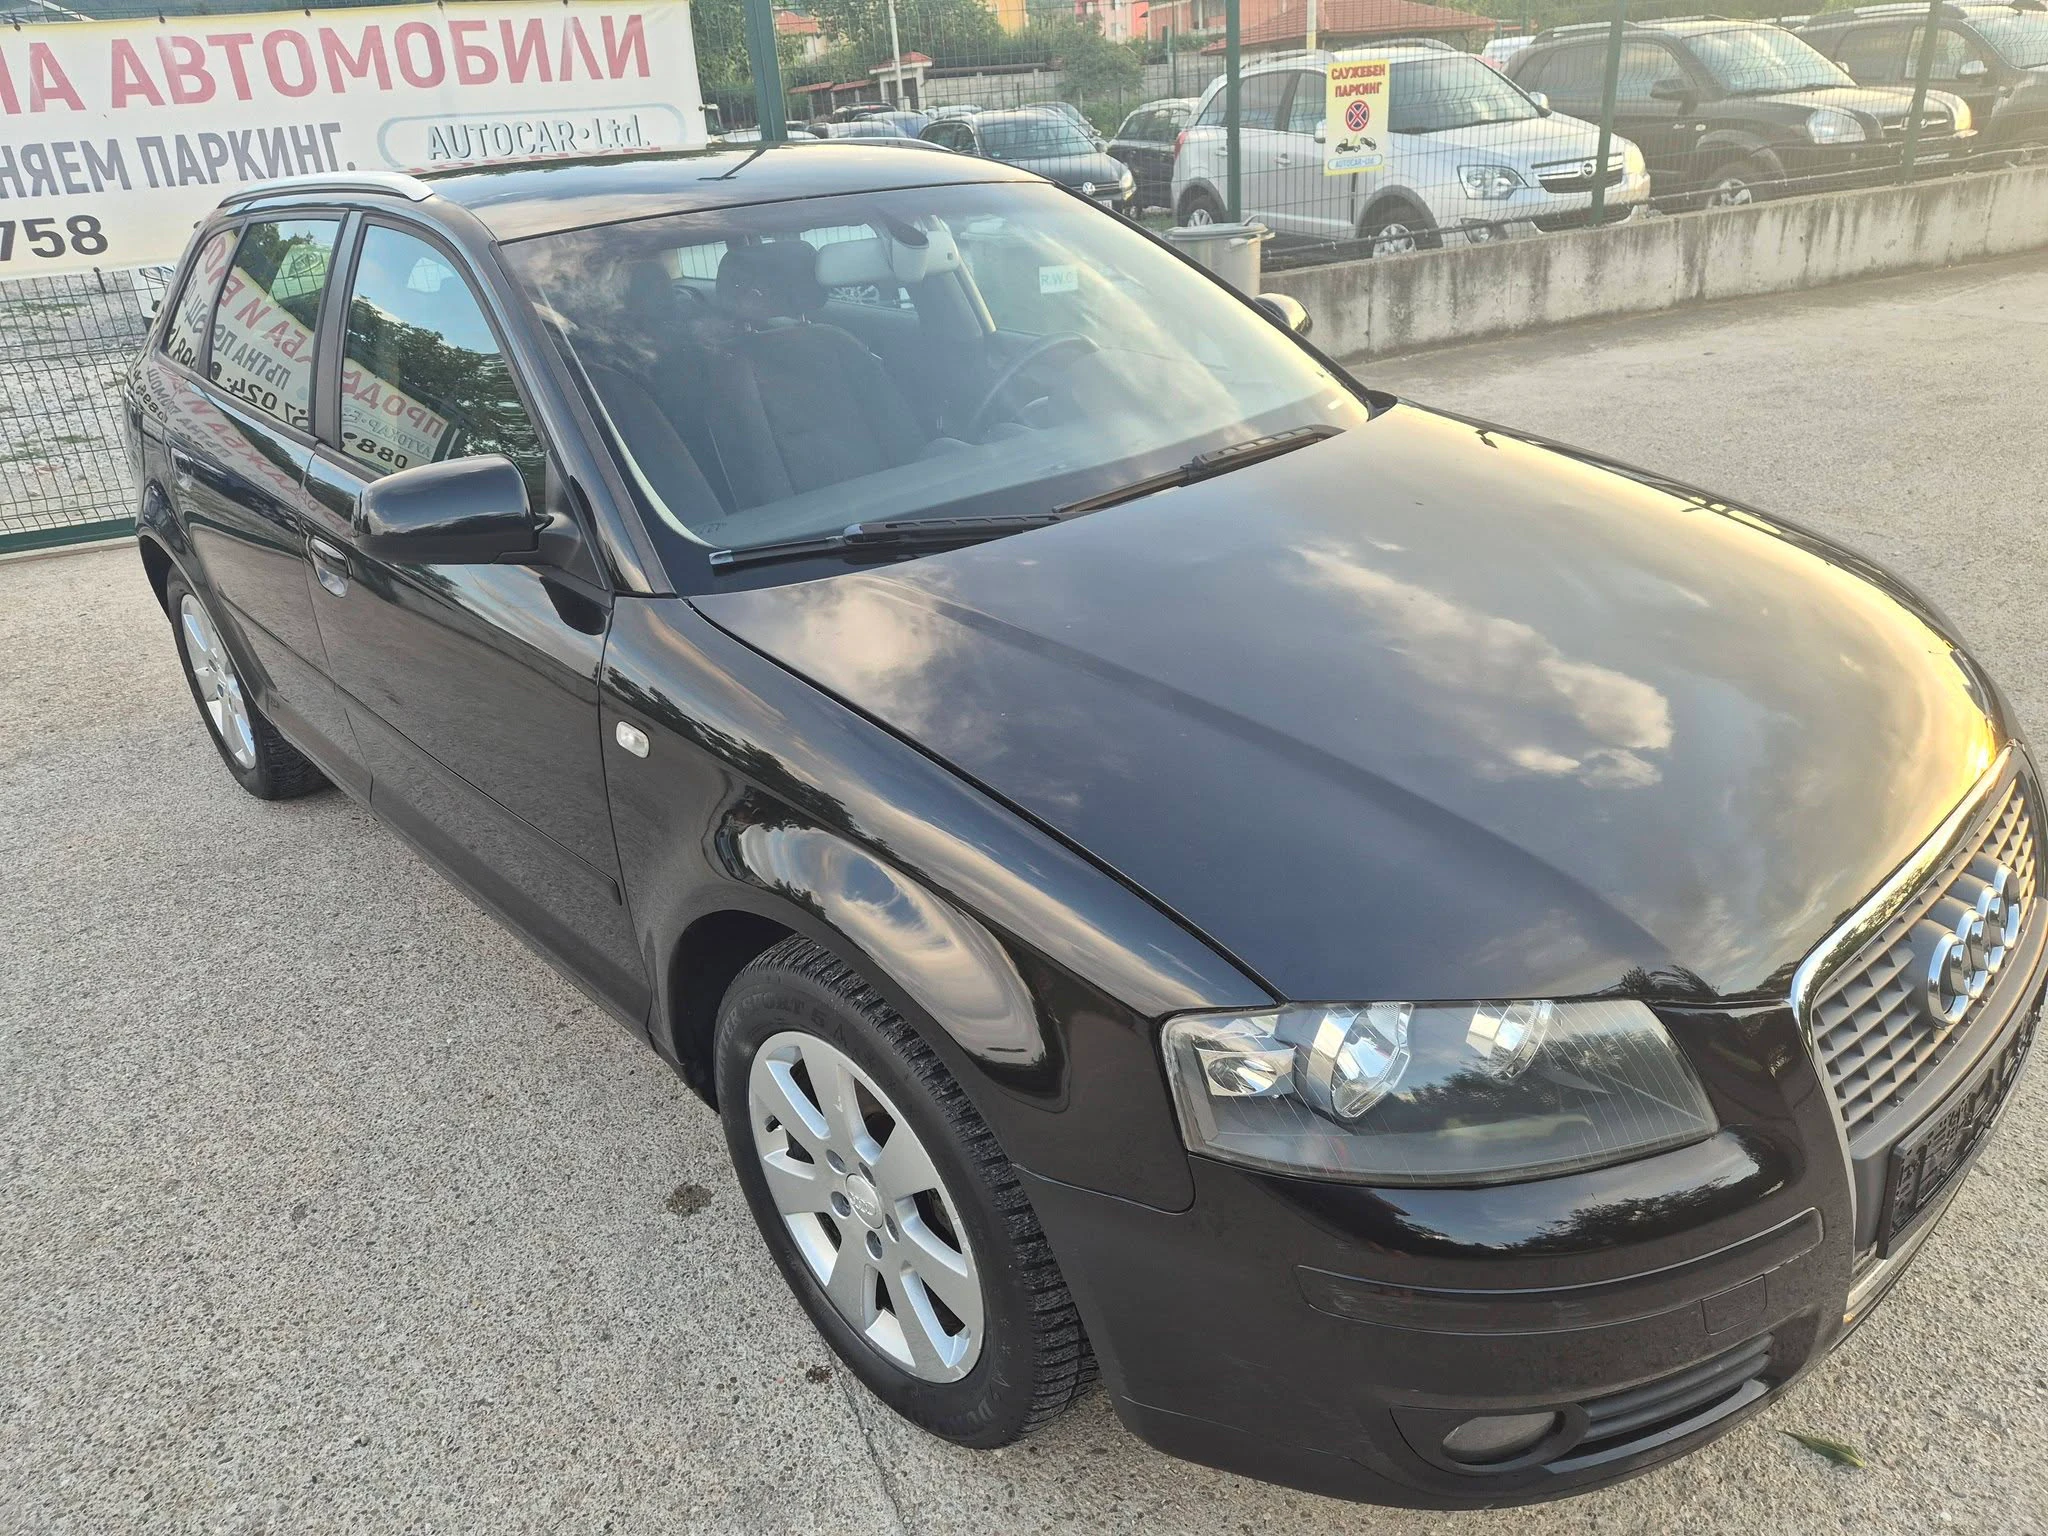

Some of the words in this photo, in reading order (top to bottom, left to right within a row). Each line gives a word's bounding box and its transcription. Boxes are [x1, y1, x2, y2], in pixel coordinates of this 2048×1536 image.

[110, 14, 651, 110] АВТОМОБИЛИ
[1331, 64, 1386, 80] СЛУЖЕБЕН
[1335, 82, 1382, 97] ПАРКИНГ
[136, 122, 355, 189] ПАРКИНГ.
